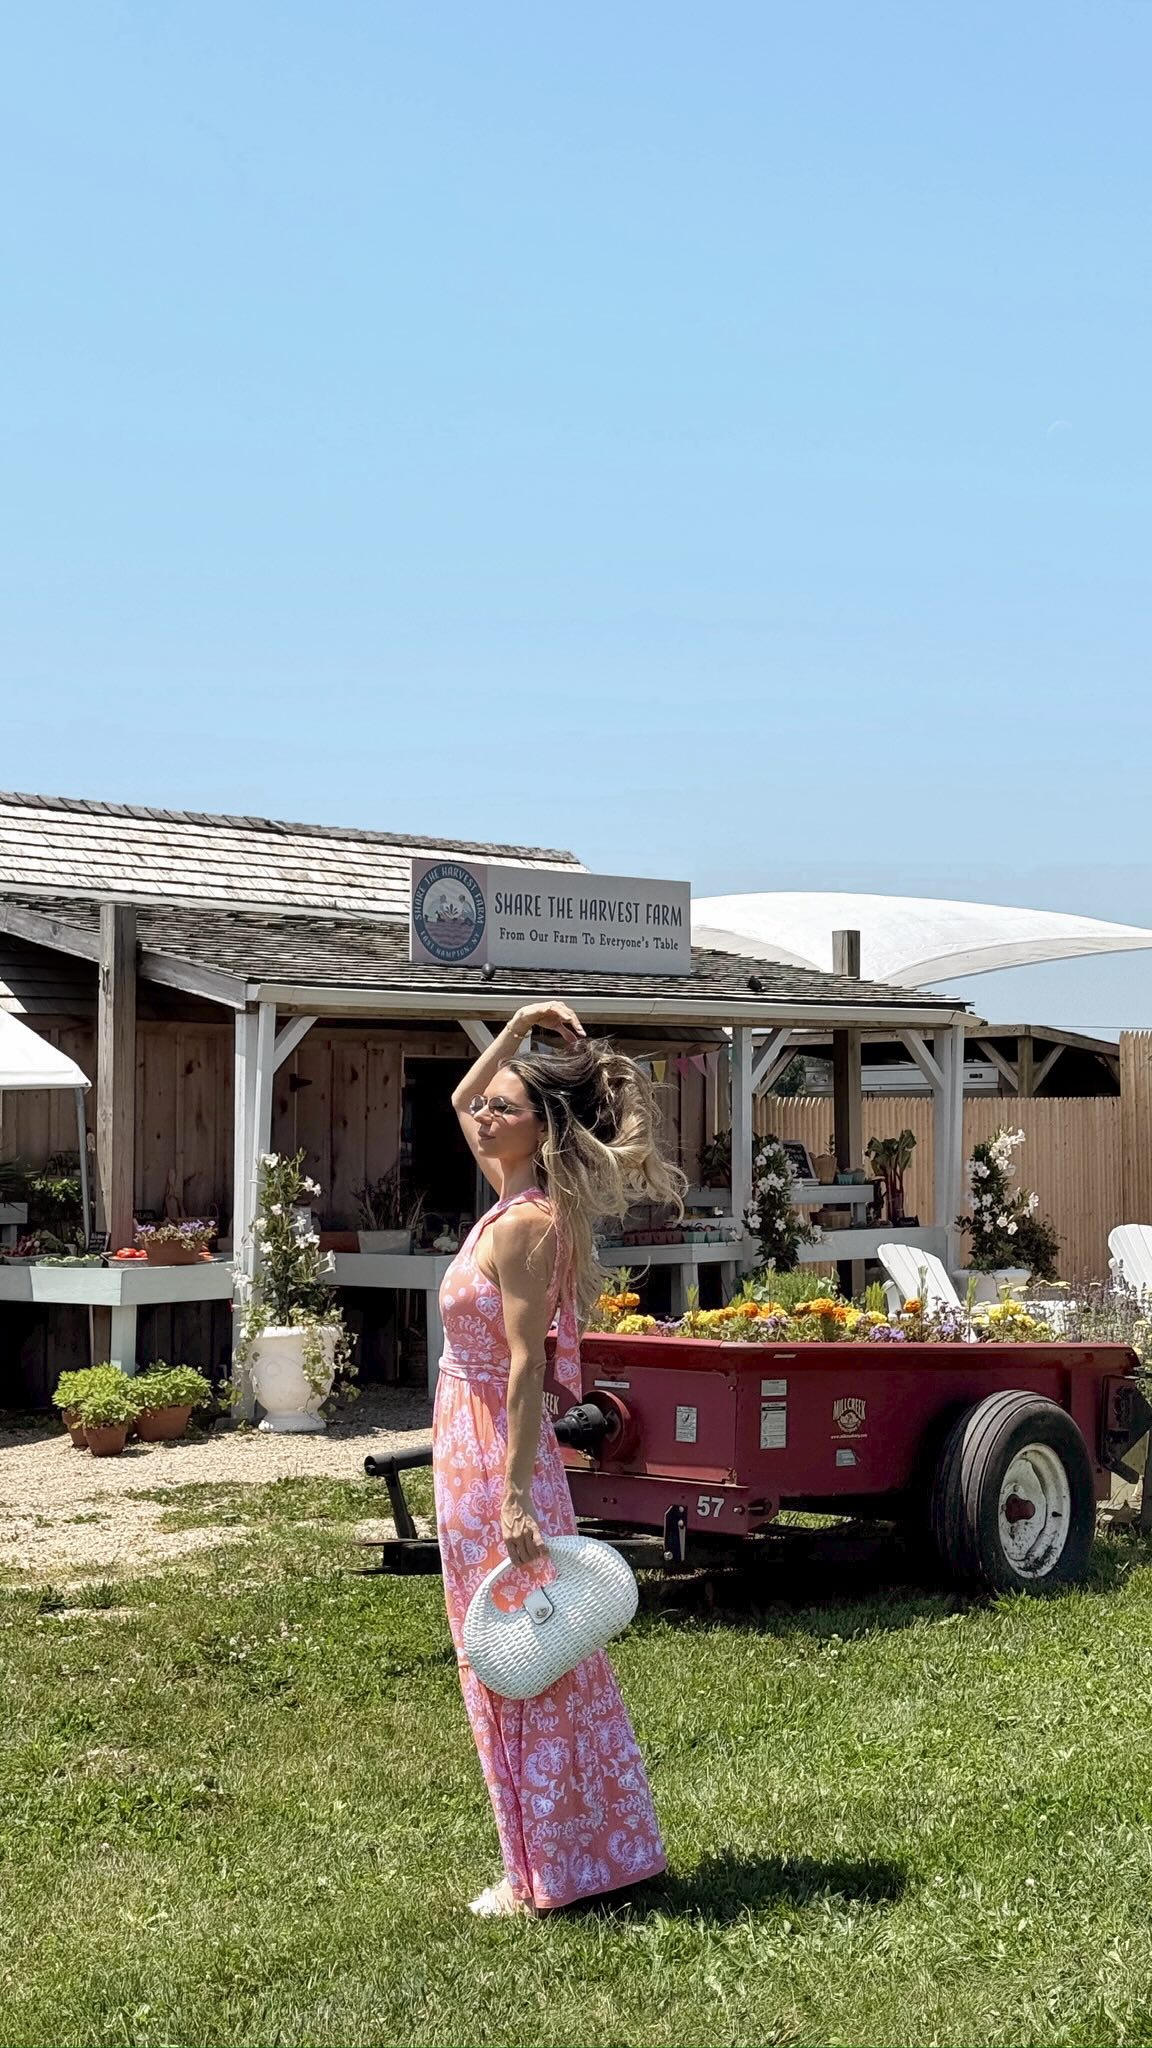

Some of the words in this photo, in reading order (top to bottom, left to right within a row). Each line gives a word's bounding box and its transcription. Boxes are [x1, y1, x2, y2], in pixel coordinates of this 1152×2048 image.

[414, 887, 426, 920] SHARE
[425, 867, 440, 885] THE
[441, 866, 477, 892] HARVEST
[474, 893, 485, 924] FARM
[494, 892, 542, 917] SHARE
[548, 896, 574, 919] THE
[579, 898, 640, 924] HARVEST
[646, 903, 682, 927] FARM
[420, 930, 436, 951] EAST
[499, 927, 525, 941] From
[529, 929, 549, 943] Our
[553, 930, 578, 945] Farm
[582, 932, 595, 945] To
[599, 933, 649, 950] Everyone's
[653, 936, 679, 951] Table
[696, 1495, 725, 1518] 57
